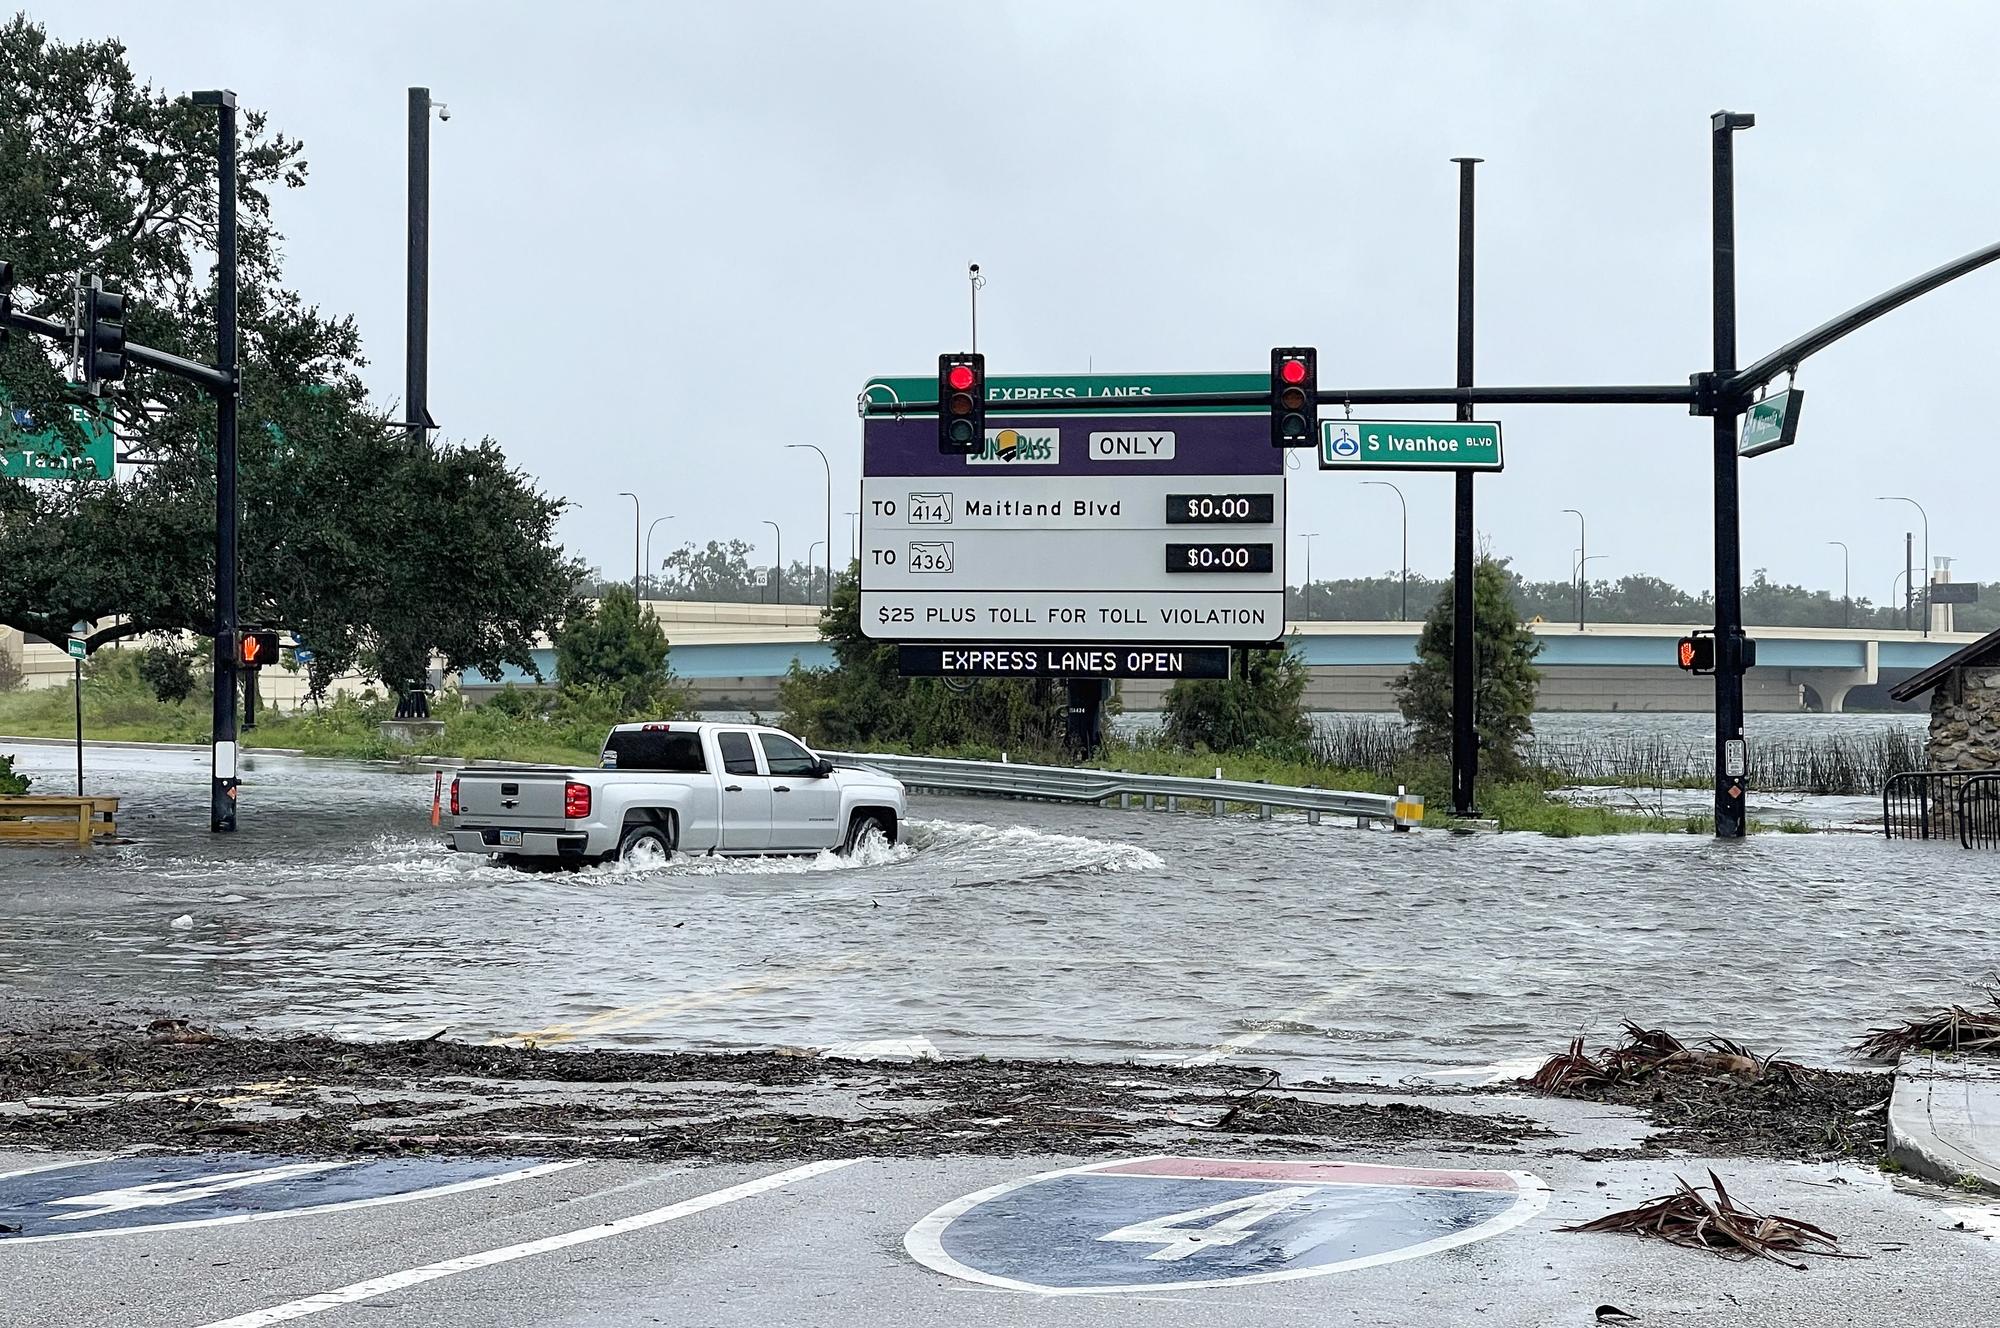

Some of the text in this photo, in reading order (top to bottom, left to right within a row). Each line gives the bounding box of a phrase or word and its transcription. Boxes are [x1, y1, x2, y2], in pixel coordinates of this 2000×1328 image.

[989, 387, 1076, 400] EXPRESS
[1100, 437, 1164, 455] ONLY
[1368, 434, 1493, 452] S Ivanhoe BLVD
[872, 500, 1121, 520] TO 414 Maitland Blvd
[1188, 499, 1249, 518] $0.00
[872, 550, 945, 570] TO 436
[1188, 548, 1249, 567] $0.00
[878, 606, 1265, 624] $25 PLUS TOLL FOR TOLL VIOLATION
[942, 651, 1183, 672] EXPRESS LANES OPEN
[1096, 1186, 1323, 1262] 4
